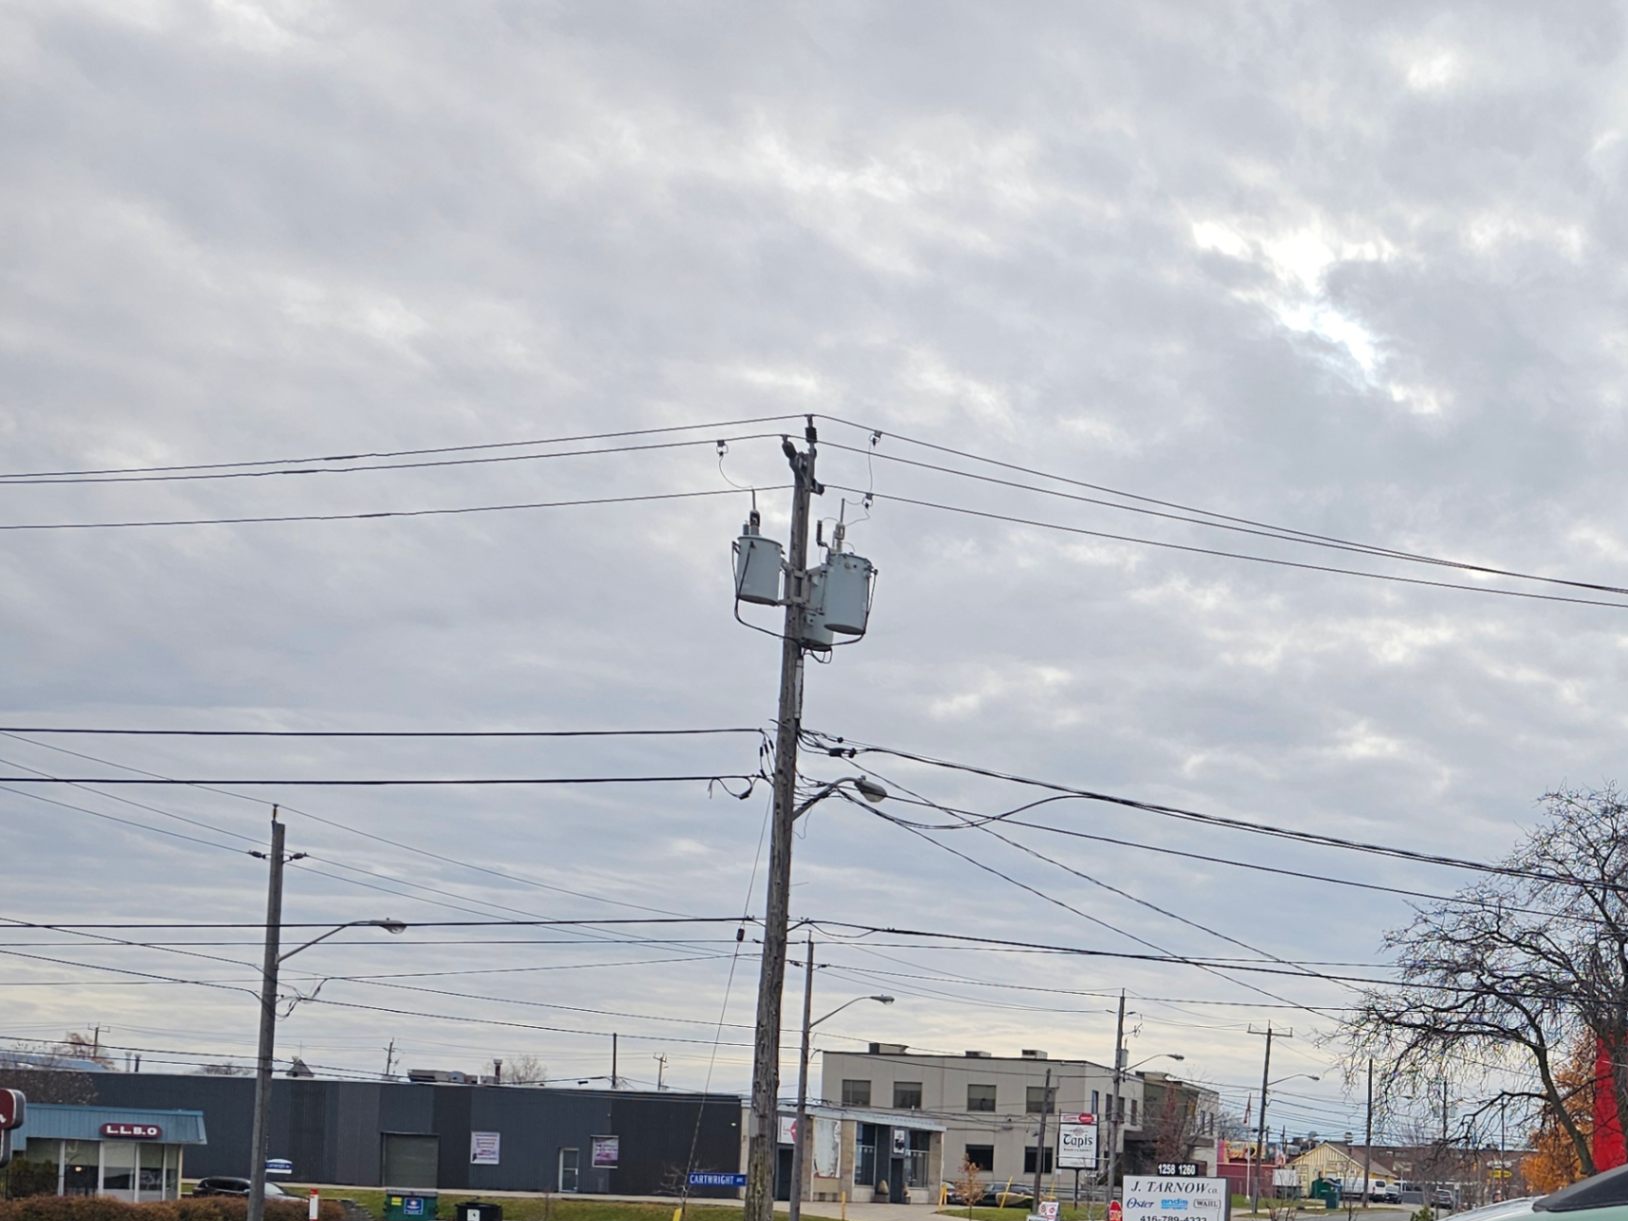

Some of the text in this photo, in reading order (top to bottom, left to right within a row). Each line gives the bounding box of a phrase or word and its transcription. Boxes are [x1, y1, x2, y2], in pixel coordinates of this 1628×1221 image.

[1158, 1164, 1195, 1175] 1258 1260
[690, 1175, 733, 1184] CARTWRIGHT
[1131, 1181, 1141, 1192] J.
[1147, 1181, 1209, 1194] TARNOW
